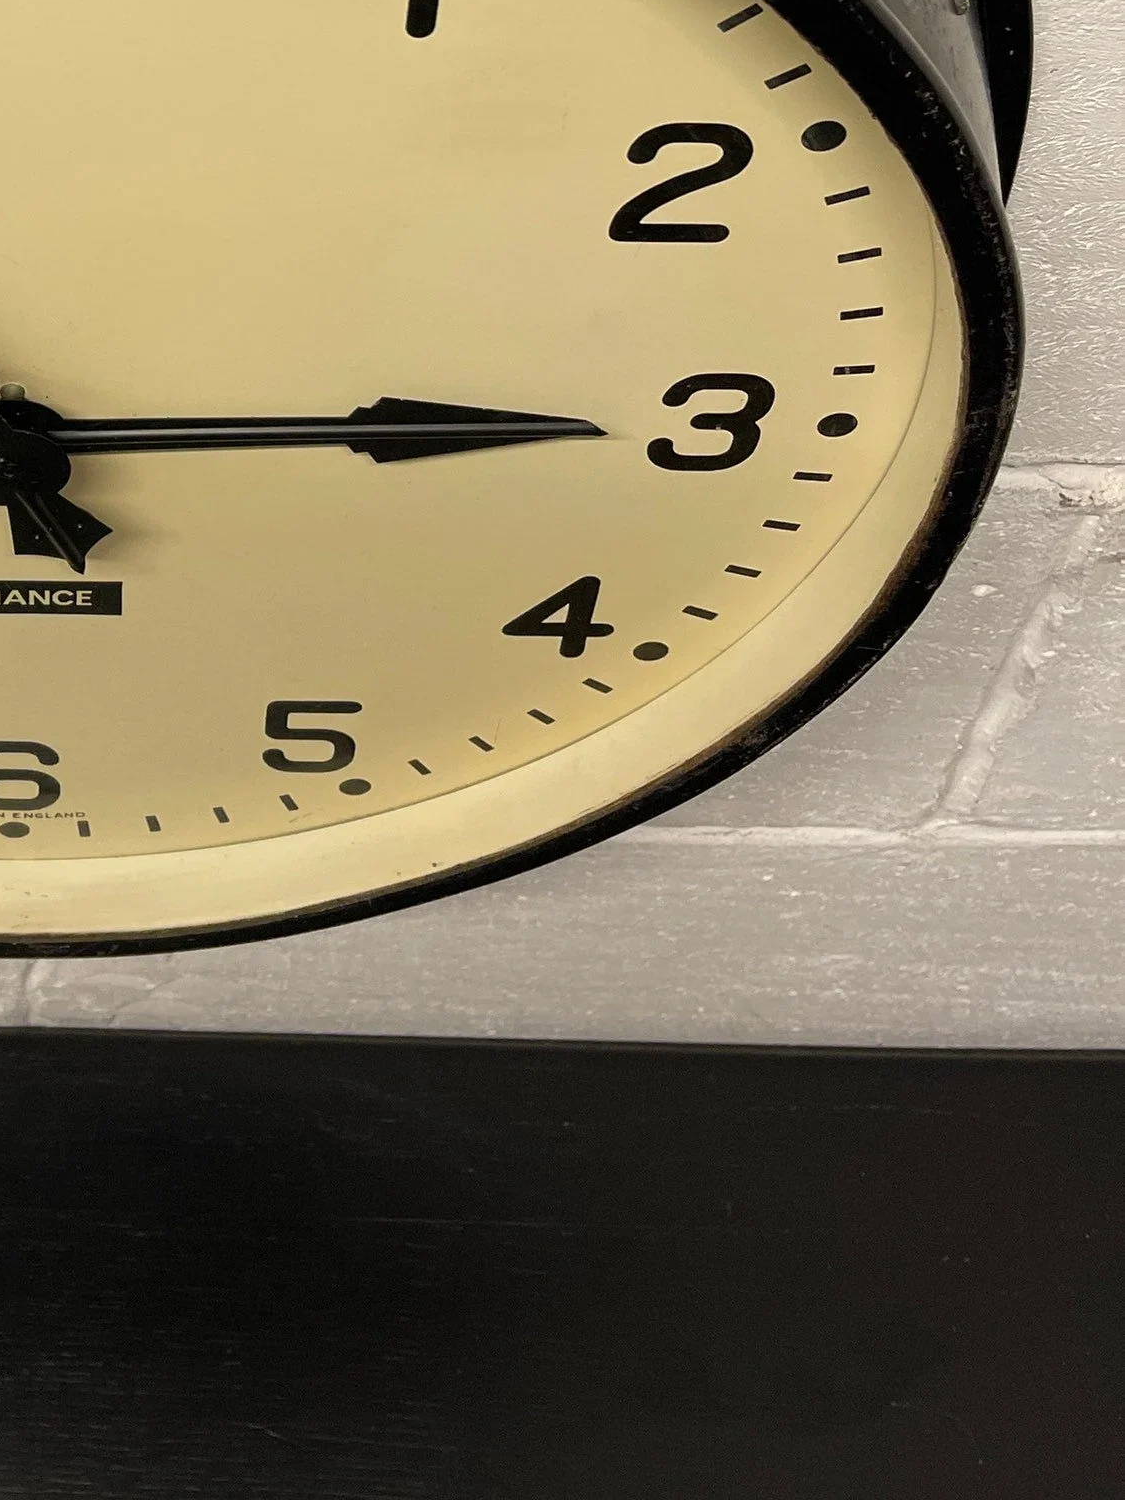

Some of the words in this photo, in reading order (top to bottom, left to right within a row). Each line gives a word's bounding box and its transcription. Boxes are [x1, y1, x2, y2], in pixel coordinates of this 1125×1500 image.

[608, 122, 754, 243] 2
[647, 373, 777, 472] 3
[501, 575, 614, 658] 4
[262, 701, 363, 773] 5
[12, 811, 86, 819] ENGLAND
